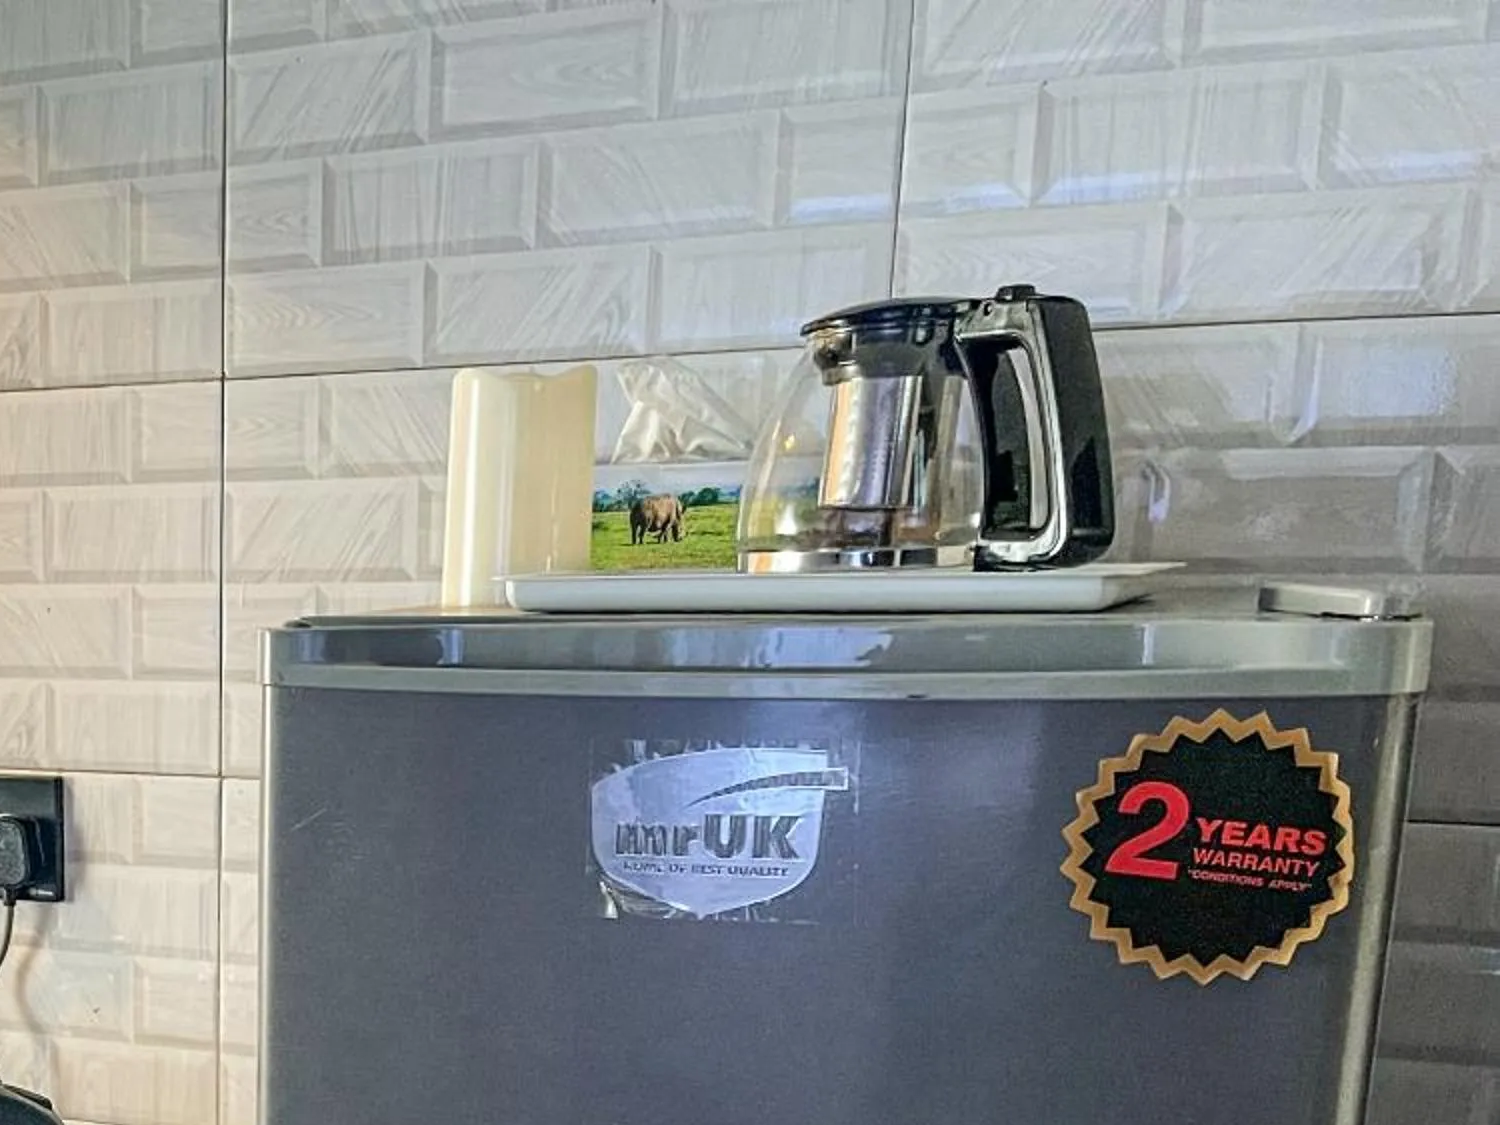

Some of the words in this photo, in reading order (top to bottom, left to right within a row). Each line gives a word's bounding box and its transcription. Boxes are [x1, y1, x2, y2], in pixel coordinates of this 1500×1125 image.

[1104, 781, 1190, 880] 2
[1196, 817, 1327, 856] YEARS
[1193, 847, 1320, 877] WARRANTY
